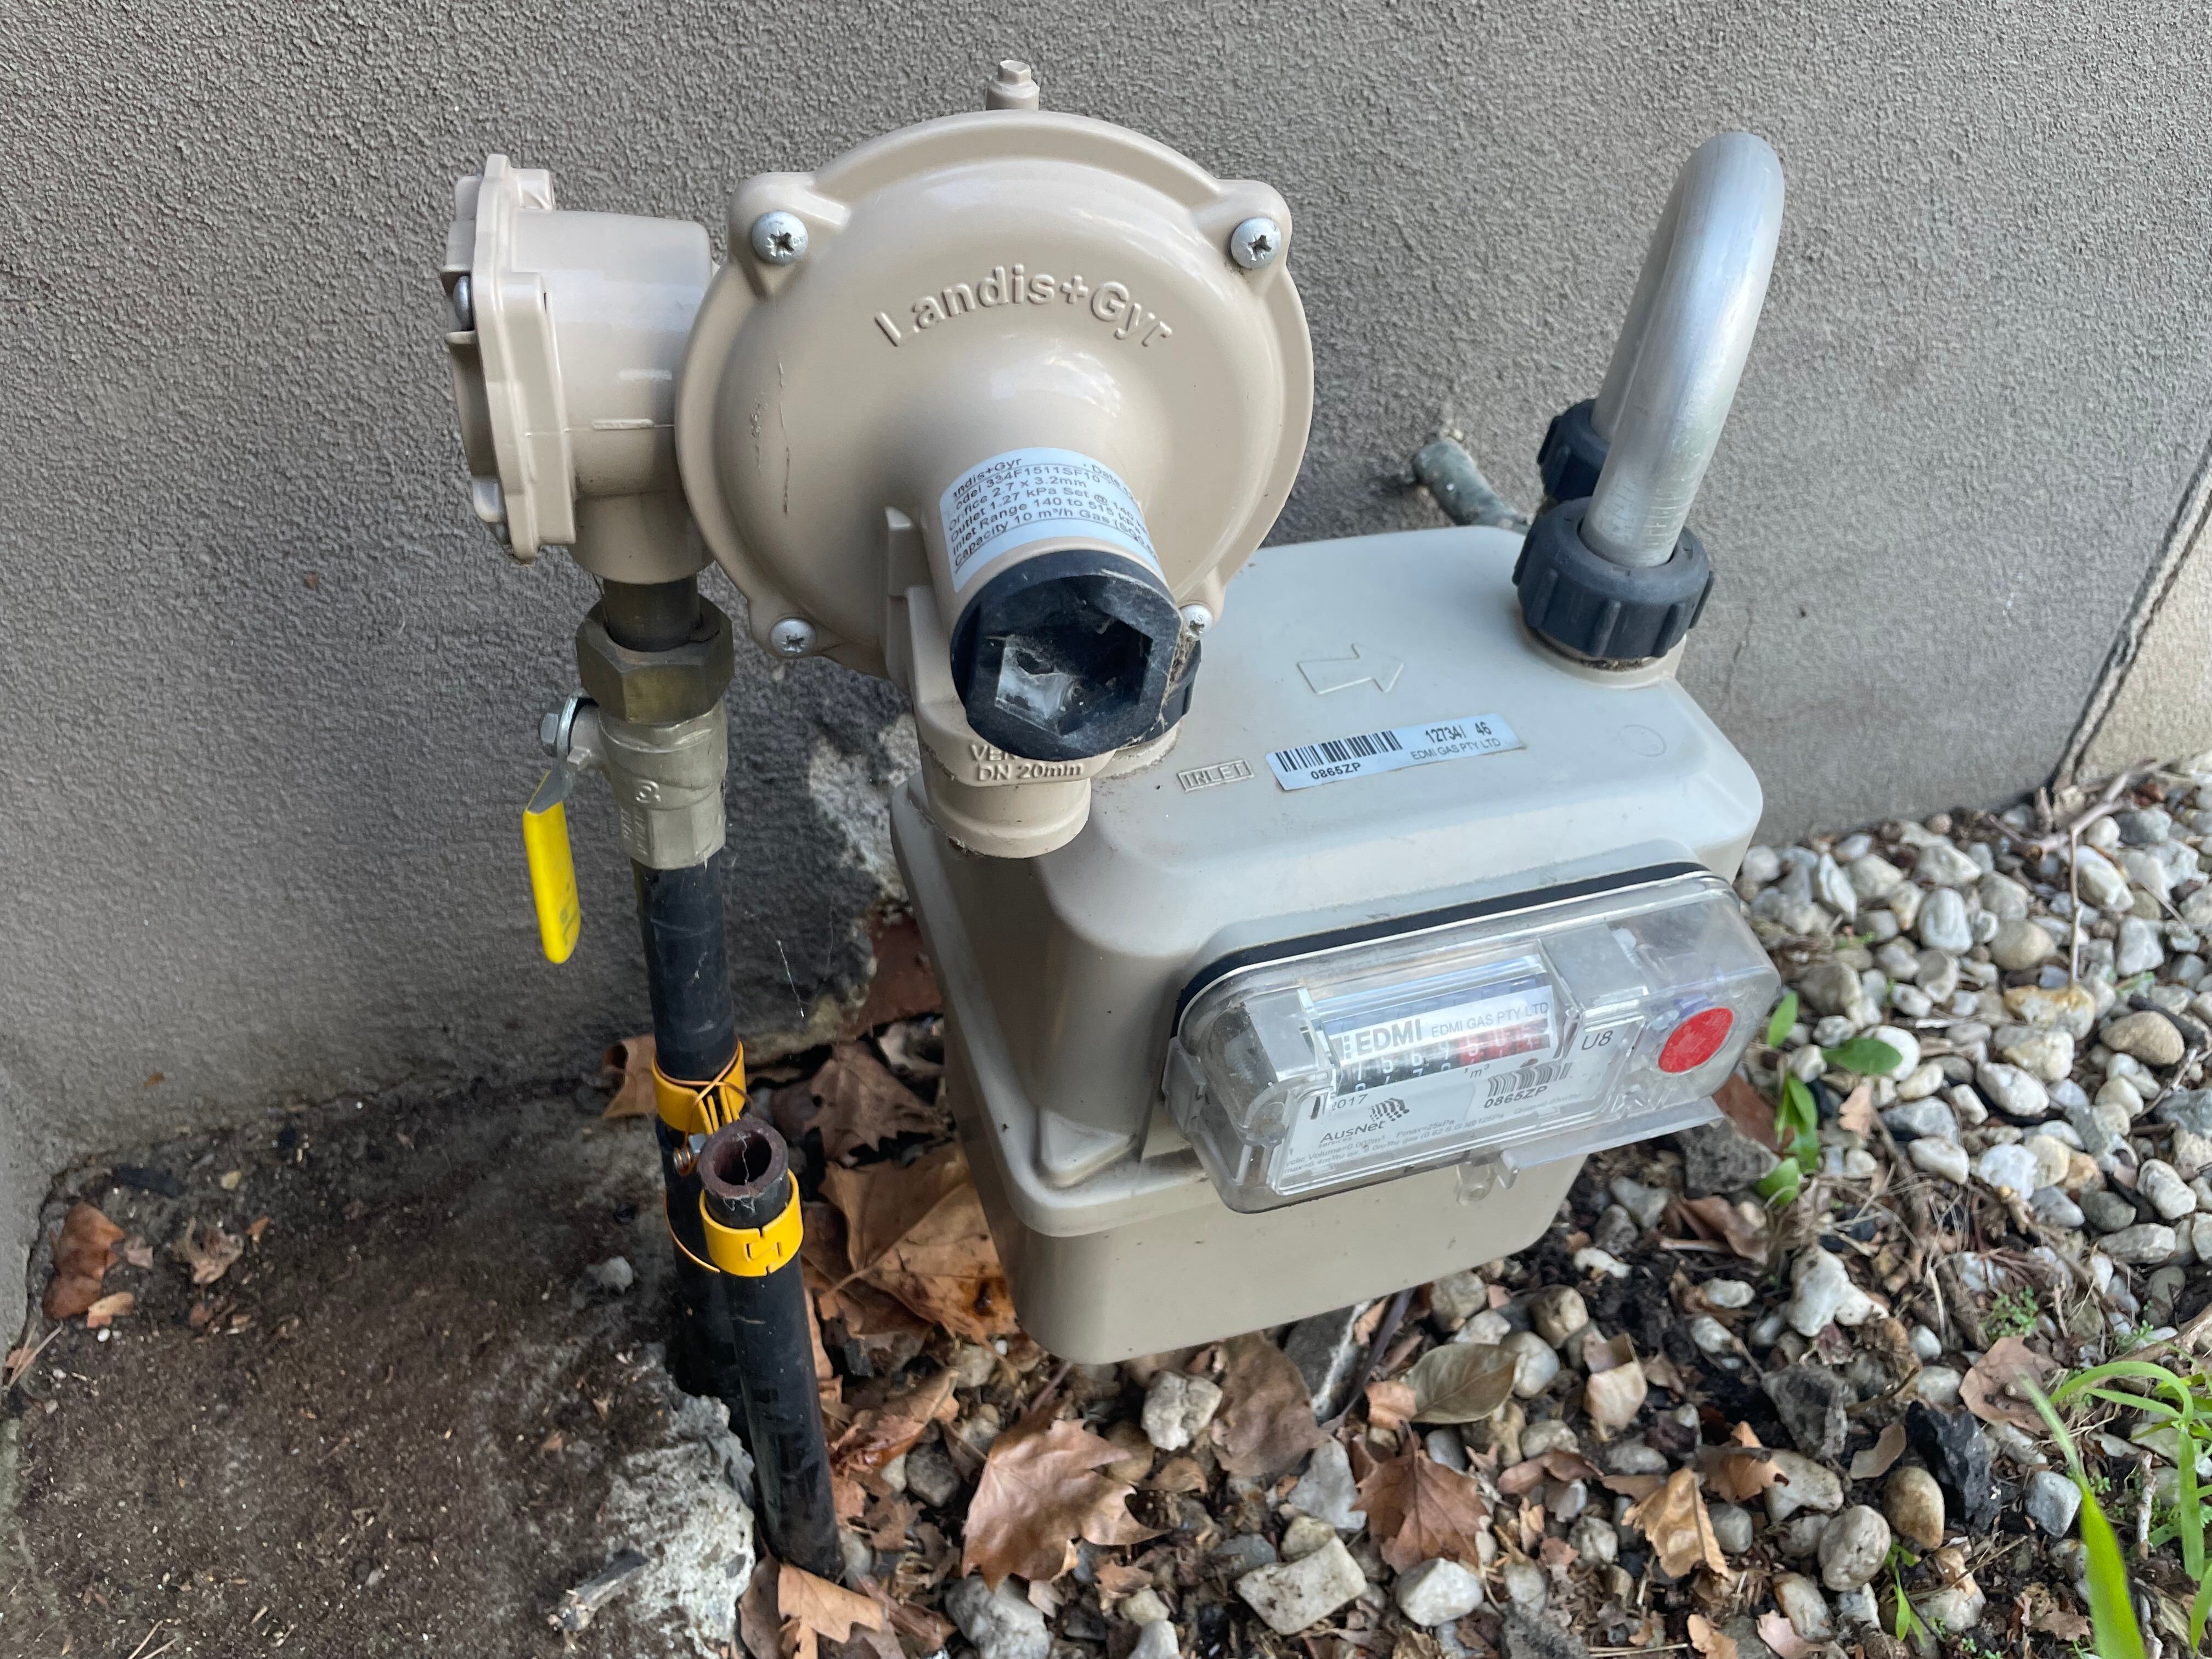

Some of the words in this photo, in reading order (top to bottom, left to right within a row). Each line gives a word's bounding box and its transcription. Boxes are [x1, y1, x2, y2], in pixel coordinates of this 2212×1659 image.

[874, 263, 1173, 348] Landis+Gyr
[956, 485, 981, 510] odel
[992, 482, 1014, 498] 2.7
[1035, 476, 1087, 488] 3.2mm
[951, 508, 986, 542] Outlet
[990, 492, 1020, 509] 1.27
[1026, 487, 1057, 497] kPa
[1063, 487, 1090, 498] Set
[1094, 494, 1109, 505] @
[953, 527, 977, 555] Inlet
[980, 504, 1028, 529] Range
[1034, 498, 1062, 507] 140
[1066, 498, 1083, 506] to
[955, 522, 1009, 567] Capacity
[1014, 512, 1032, 523] 10
[1079, 510, 1110, 523] Gas
[1474, 721, 1492, 736] 46
[1410, 748, 1437, 760] EDMI
[1437, 744, 1459, 755] GAS
[1459, 741, 1479, 752] PTY
[1480, 737, 1500, 749] LTD
[978, 763, 1011, 781] DN
[1018, 762, 1084, 778] 20mm
[1183, 762, 1245, 787] INLET
[1310, 761, 1361, 780] 0865ZP
[1431, 1019, 1463, 1038] EDMI
[1467, 1011, 1493, 1030] GAS
[1497, 1007, 1521, 1026] PTY
[1525, 1002, 1549, 1017] LTD
[1355, 1018, 1422, 1056] EDMI
[1581, 1030, 1613, 1051] U8
[1483, 1085, 1548, 1109] 0865ZP
[1318, 1137, 1352, 1149] services
[1320, 1120, 1386, 1143] AusNet
